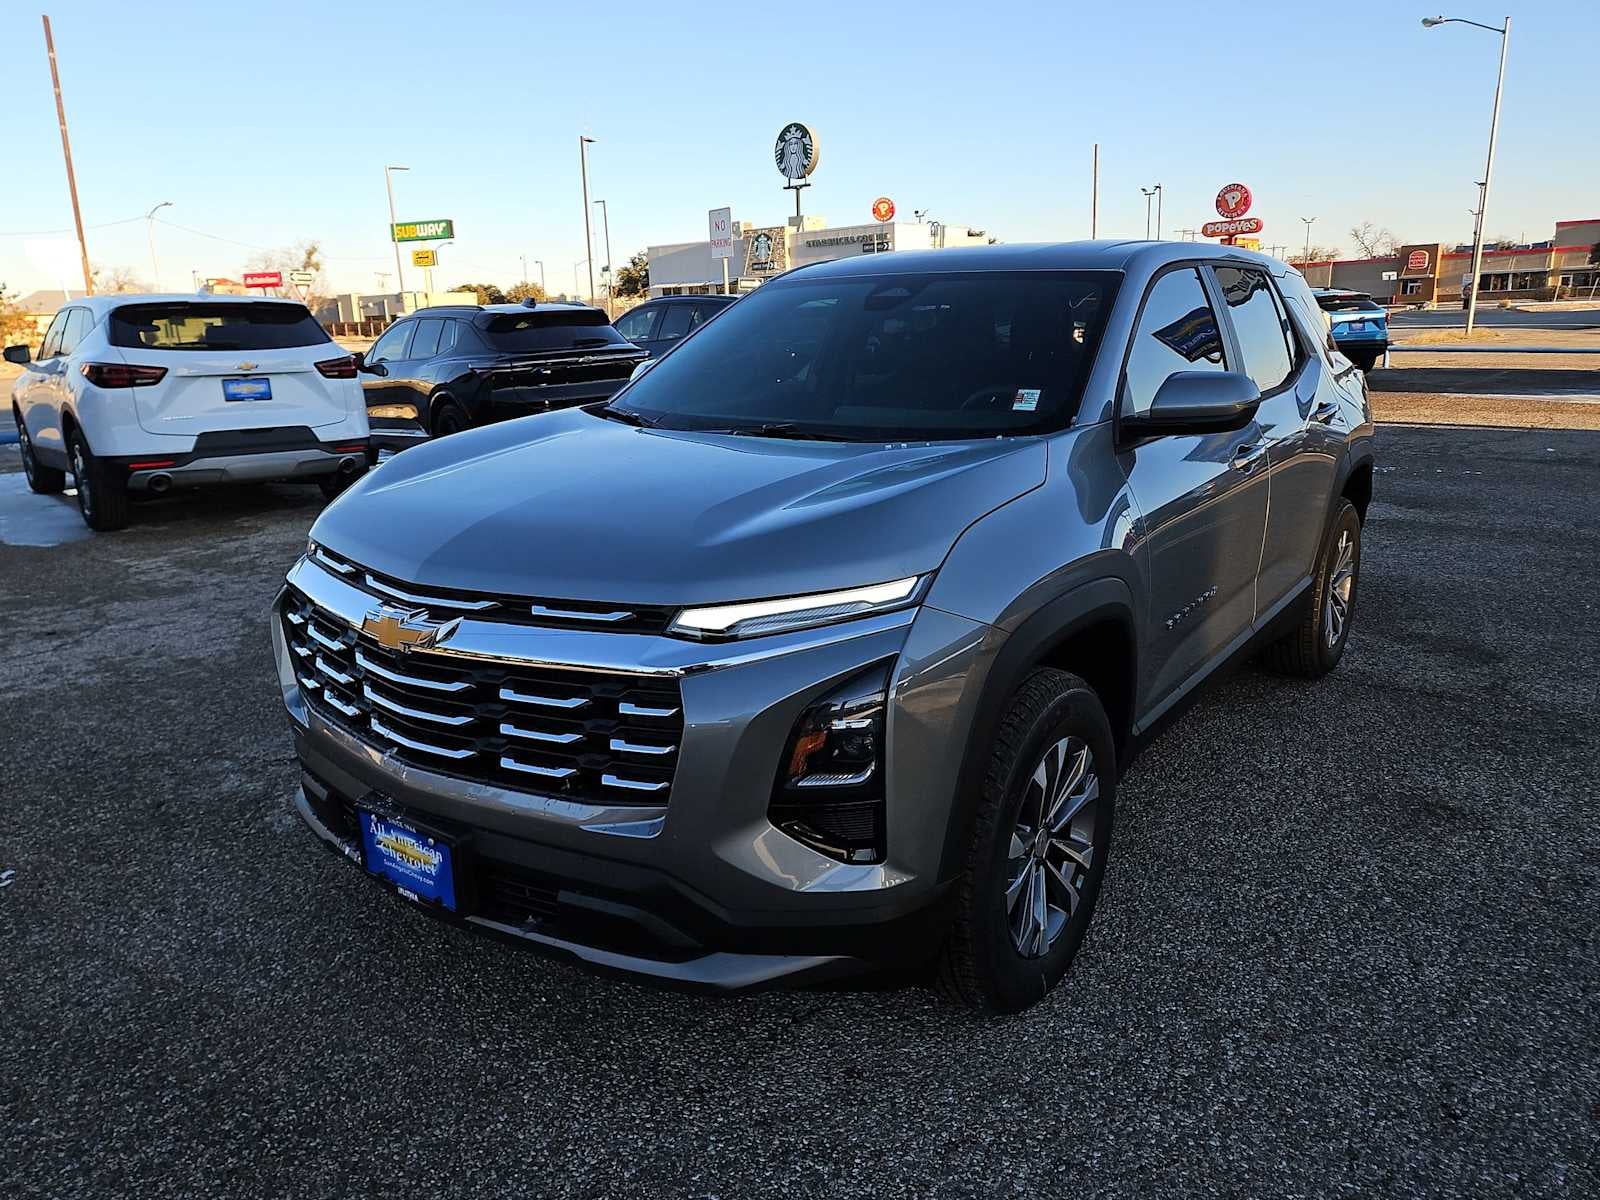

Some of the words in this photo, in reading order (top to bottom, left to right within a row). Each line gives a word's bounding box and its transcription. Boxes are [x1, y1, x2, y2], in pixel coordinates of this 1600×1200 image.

[396, 222, 447, 238] SUBWAY
[714, 219, 726, 232] NO
[711, 239, 731, 248] PARKING
[805, 235, 857, 248] STARBUCKS
